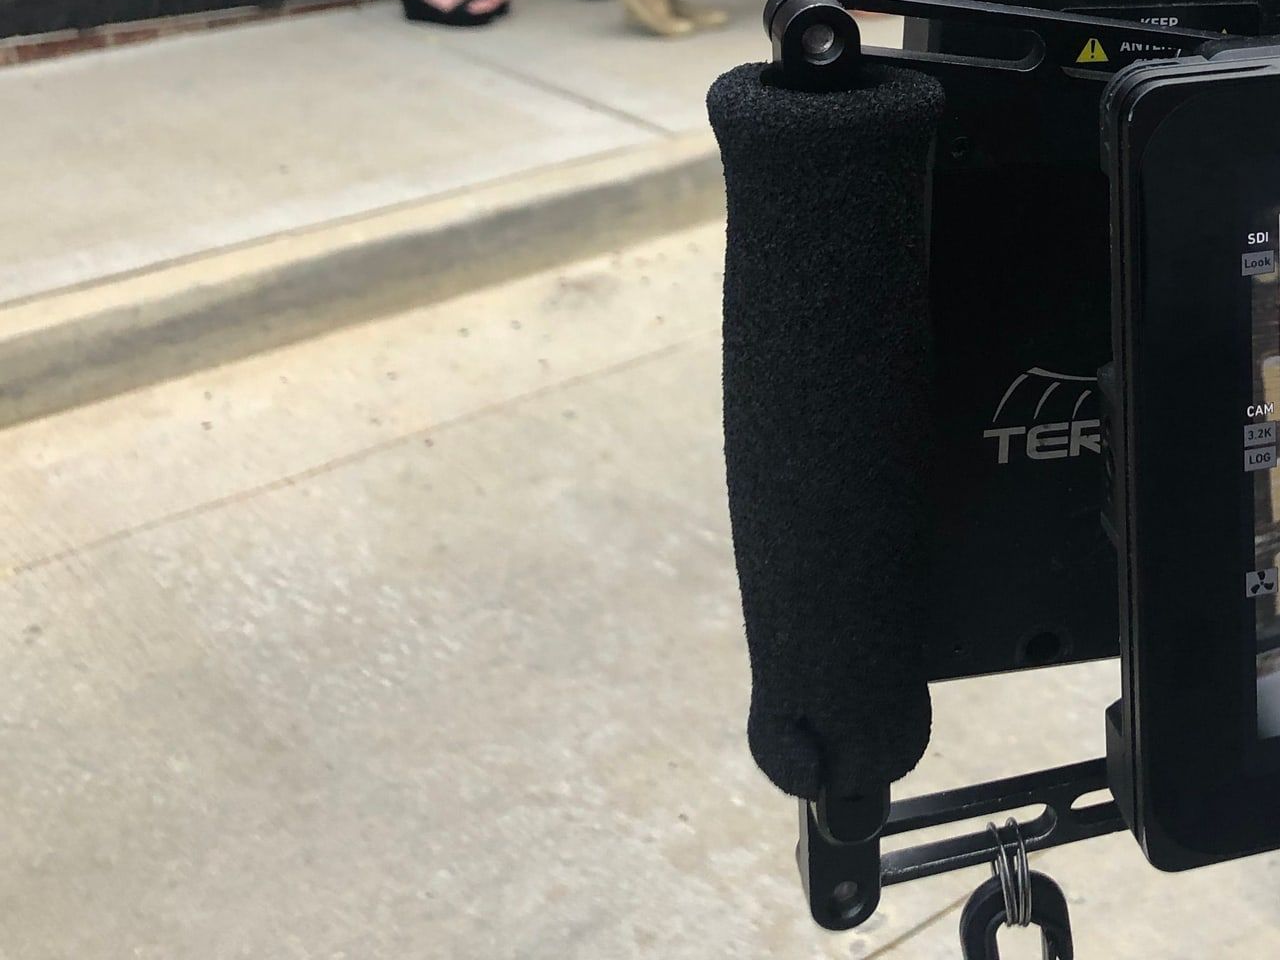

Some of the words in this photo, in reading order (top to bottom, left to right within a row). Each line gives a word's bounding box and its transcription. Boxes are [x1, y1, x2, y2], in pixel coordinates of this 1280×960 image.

[1247, 231, 1269, 245] SDI
[1244, 256, 1271, 269] Look
[1246, 403, 1274, 418] CAM
[1247, 427, 1272, 440] 3.2K
[1249, 452, 1271, 465] LOG
